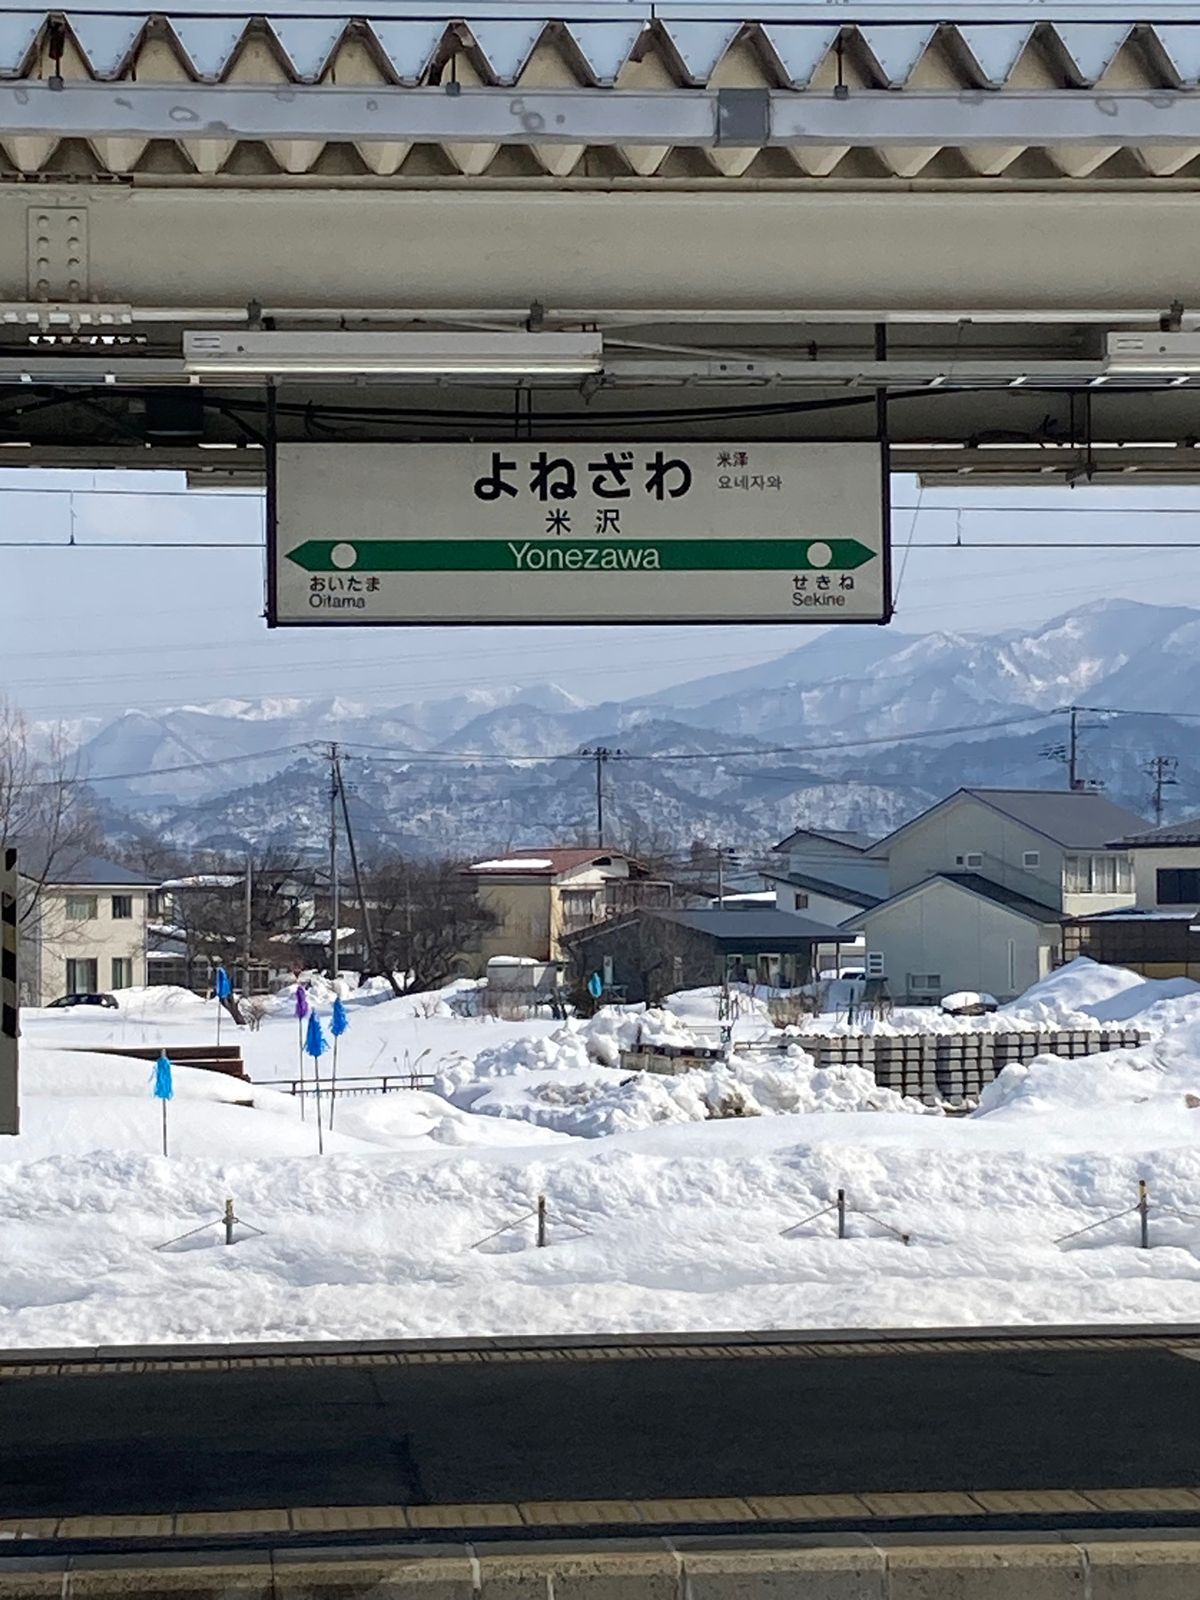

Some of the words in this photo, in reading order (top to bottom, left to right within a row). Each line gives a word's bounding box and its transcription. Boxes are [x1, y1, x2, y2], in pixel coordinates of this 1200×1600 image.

[473, 450, 692, 501] よねざわ
[718, 475, 783, 490] 요네자와
[545, 508, 621, 535] 米沢
[507, 543, 660, 570] Yonezawa
[310, 576, 380, 592] おいたま
[793, 574, 854, 590] せきね
[309, 593, 365, 608] Oitama
[792, 592, 846, 606] Sekine
